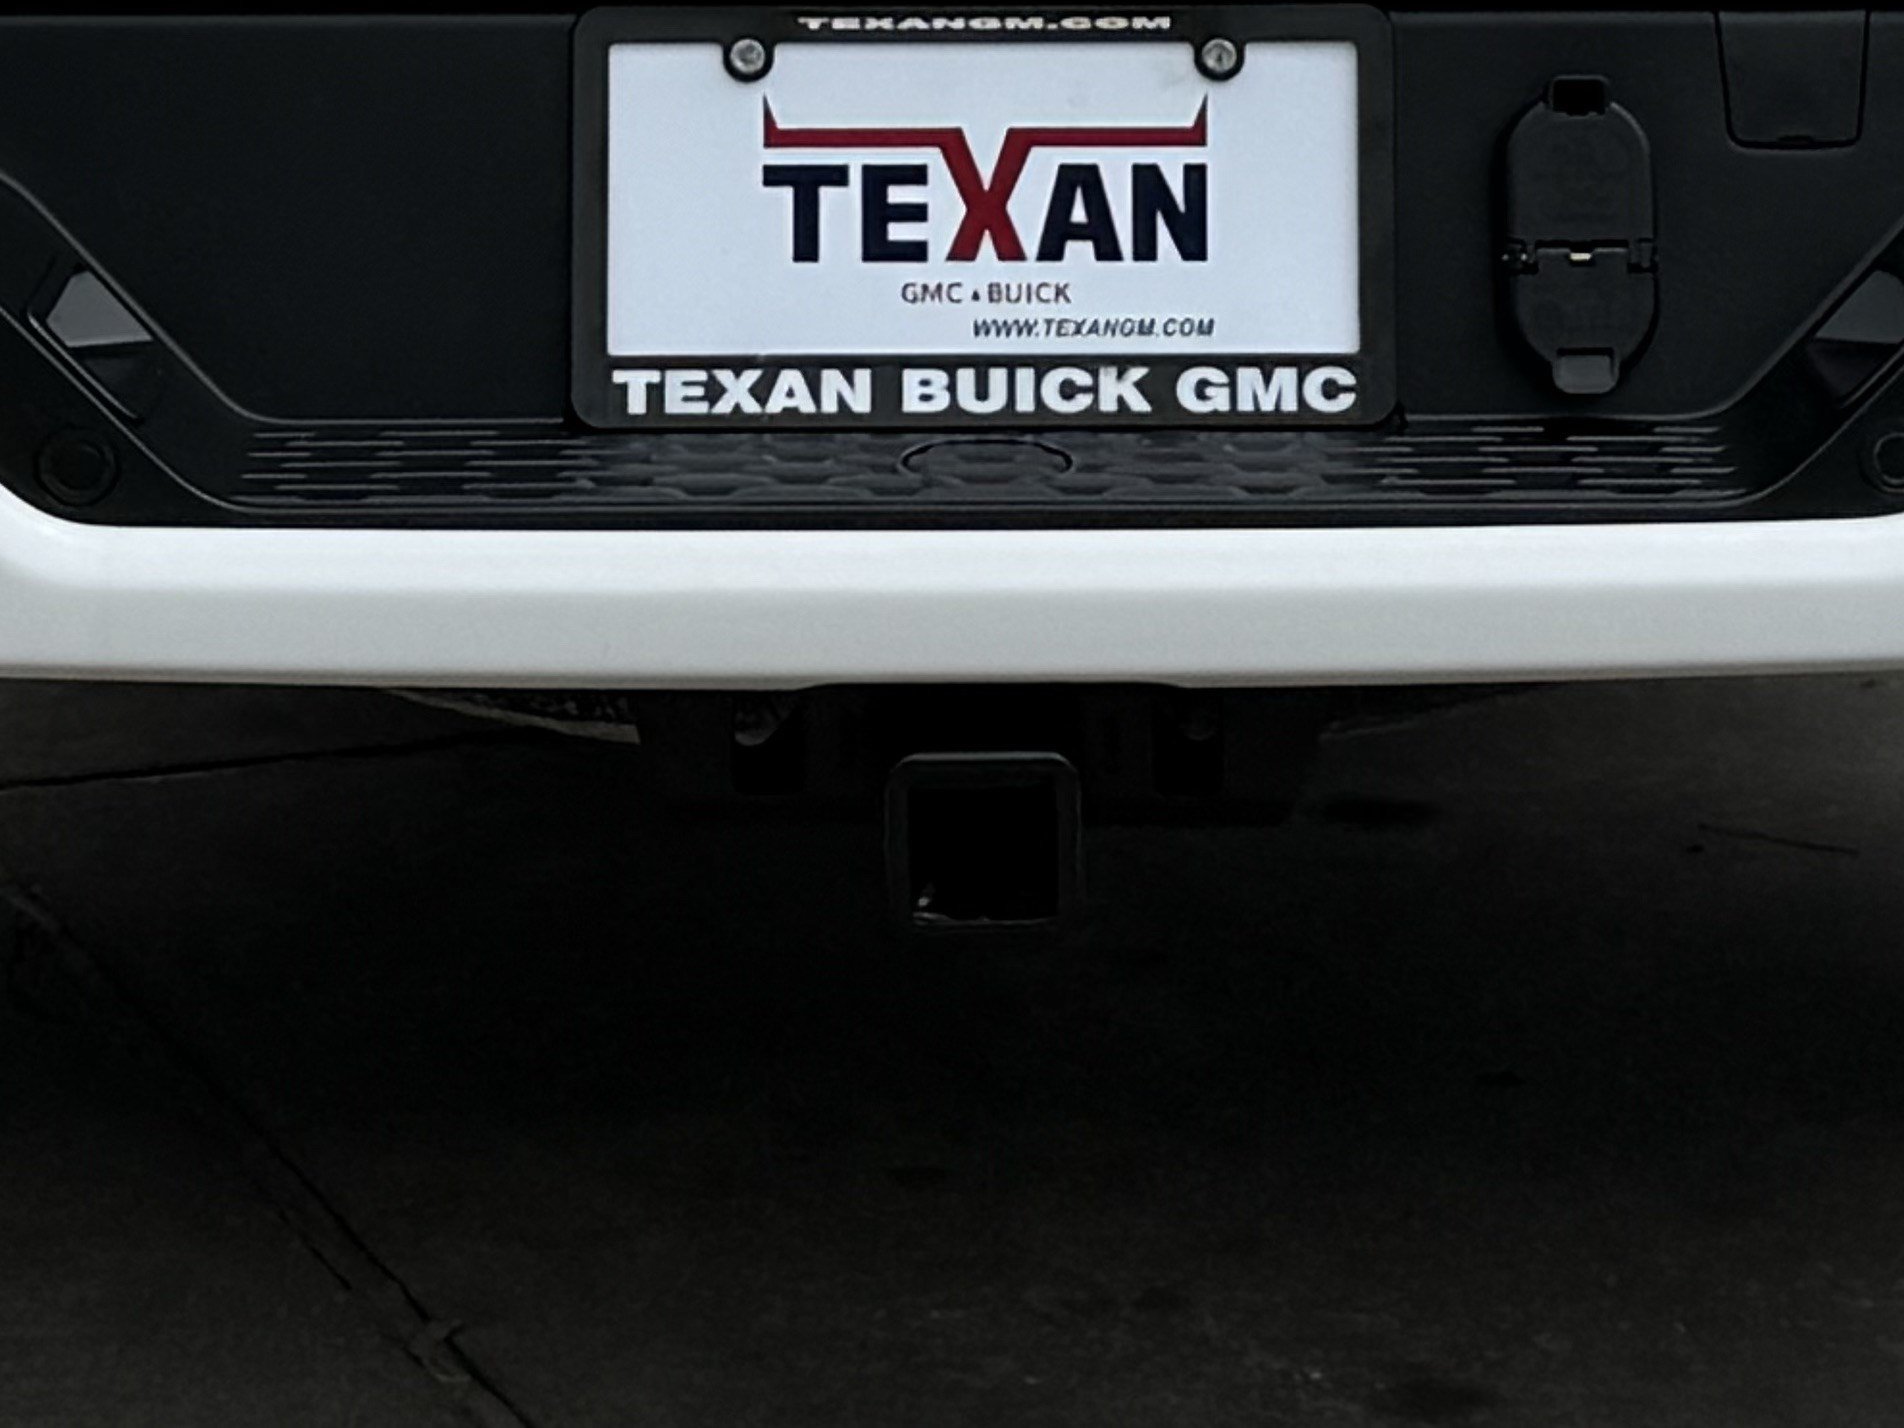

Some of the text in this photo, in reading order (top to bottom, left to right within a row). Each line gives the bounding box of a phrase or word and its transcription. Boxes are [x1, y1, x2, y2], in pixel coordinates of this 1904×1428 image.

[762, 127, 1208, 262] TEXAN
[901, 282, 1072, 304] GMC BUICK
[611, 365, 1360, 415] TEXAN BUICK GMC
